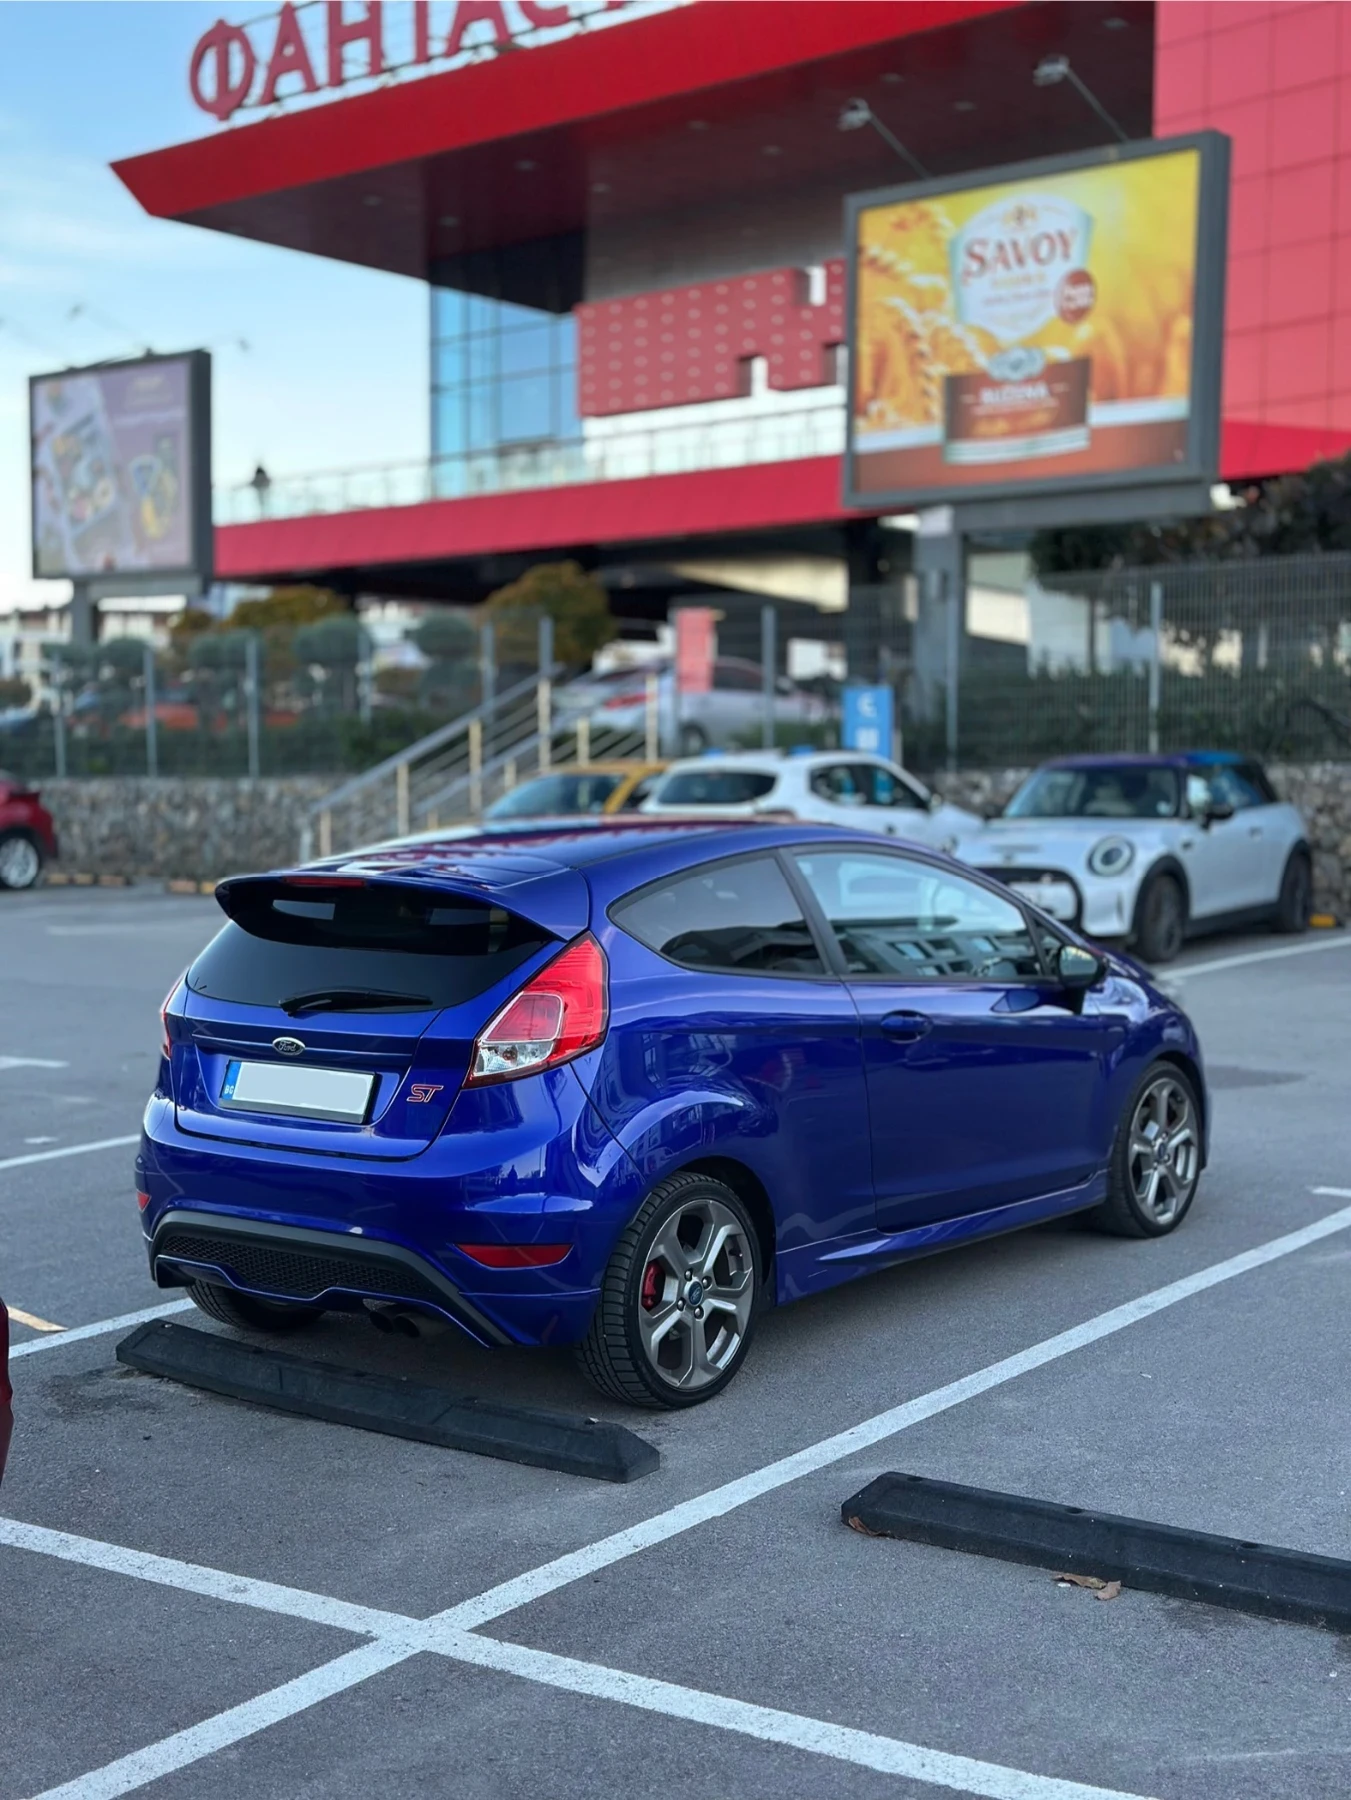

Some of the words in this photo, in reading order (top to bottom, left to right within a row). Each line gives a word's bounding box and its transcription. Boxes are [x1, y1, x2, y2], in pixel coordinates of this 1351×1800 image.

[189, 1, 625, 121] ФАНА
[961, 229, 1077, 287] SAVOY
[278, 1040, 297, 1052] Ford
[224, 1084, 235, 1095] BG
[406, 1083, 444, 1103] ST
